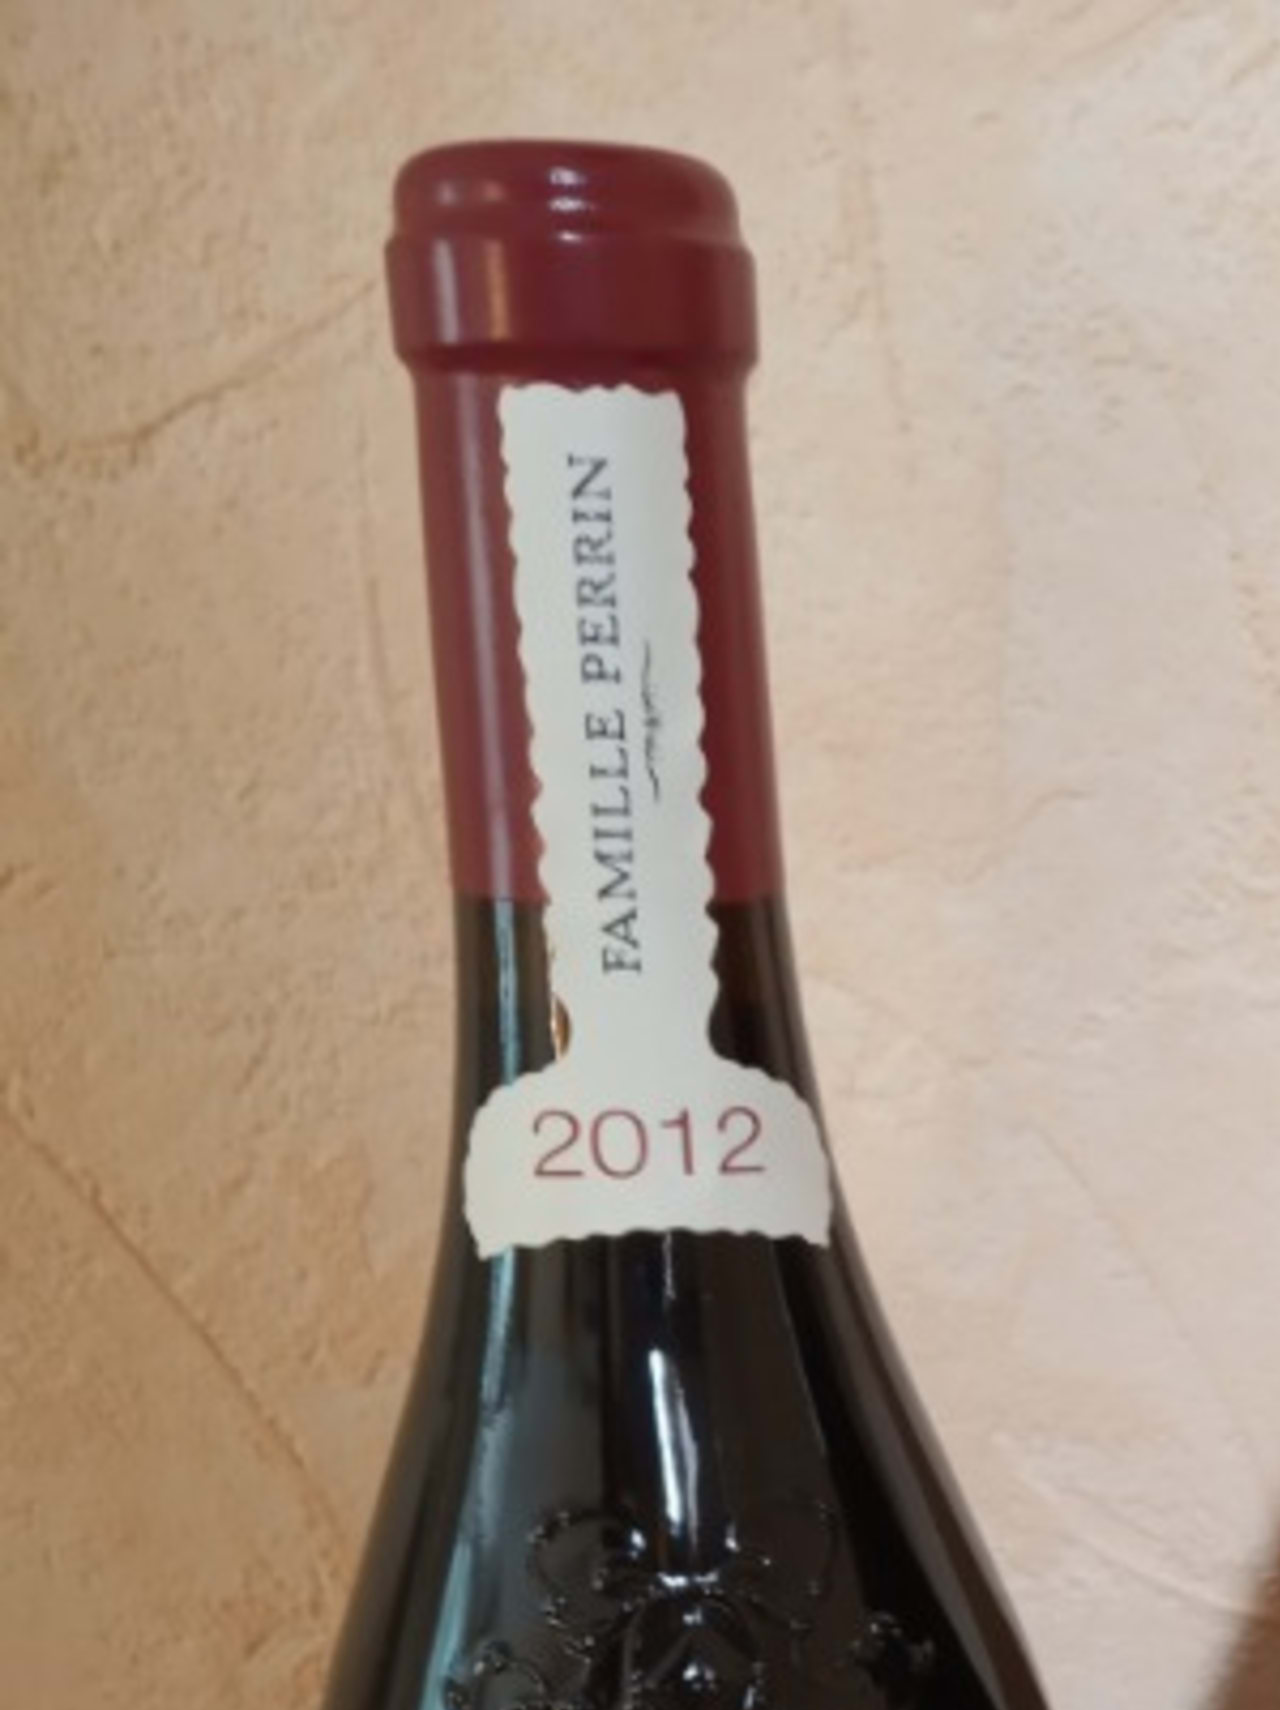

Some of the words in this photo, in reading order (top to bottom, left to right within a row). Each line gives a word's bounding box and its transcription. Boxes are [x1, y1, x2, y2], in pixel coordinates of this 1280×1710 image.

[567, 453, 623, 682] PERRIN
[582, 709, 643, 976] FAMILLE
[531, 1105, 768, 1181] 2012
